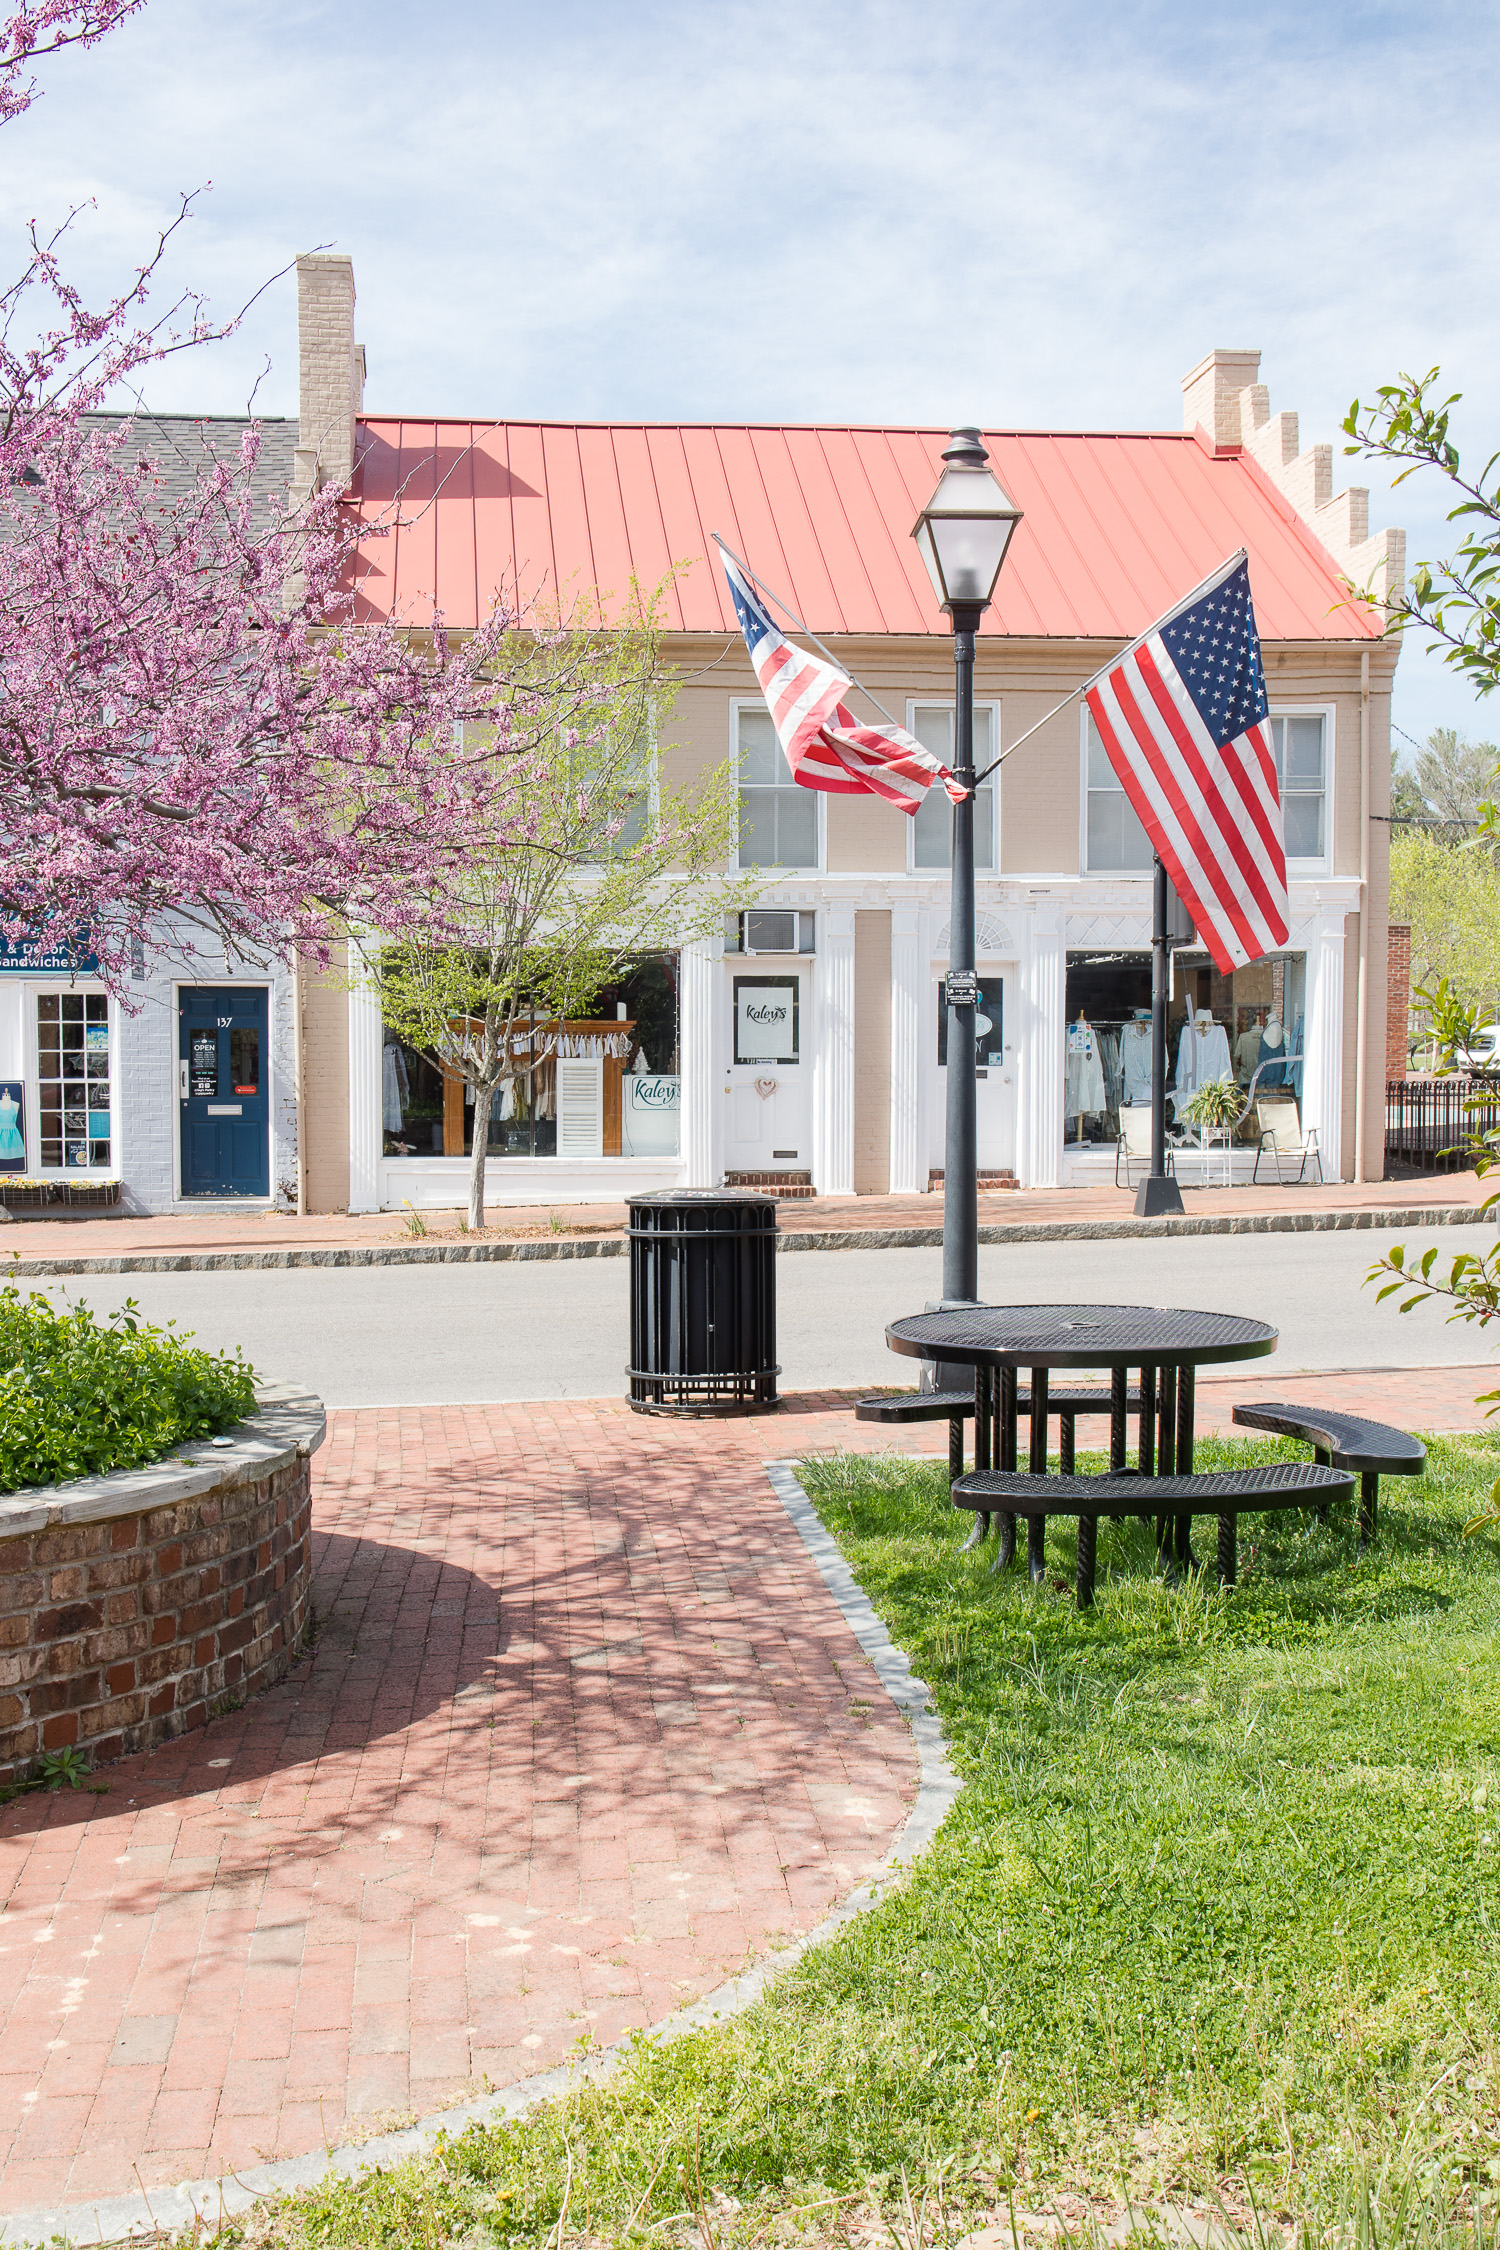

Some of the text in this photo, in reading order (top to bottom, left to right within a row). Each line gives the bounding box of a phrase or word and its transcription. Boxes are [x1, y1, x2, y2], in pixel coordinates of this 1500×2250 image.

[7, 943, 17, 955] &
[0, 956, 77, 968] andwiches
[216, 1017, 233, 1028] 137
[194, 1044, 215, 1052] OPEN
